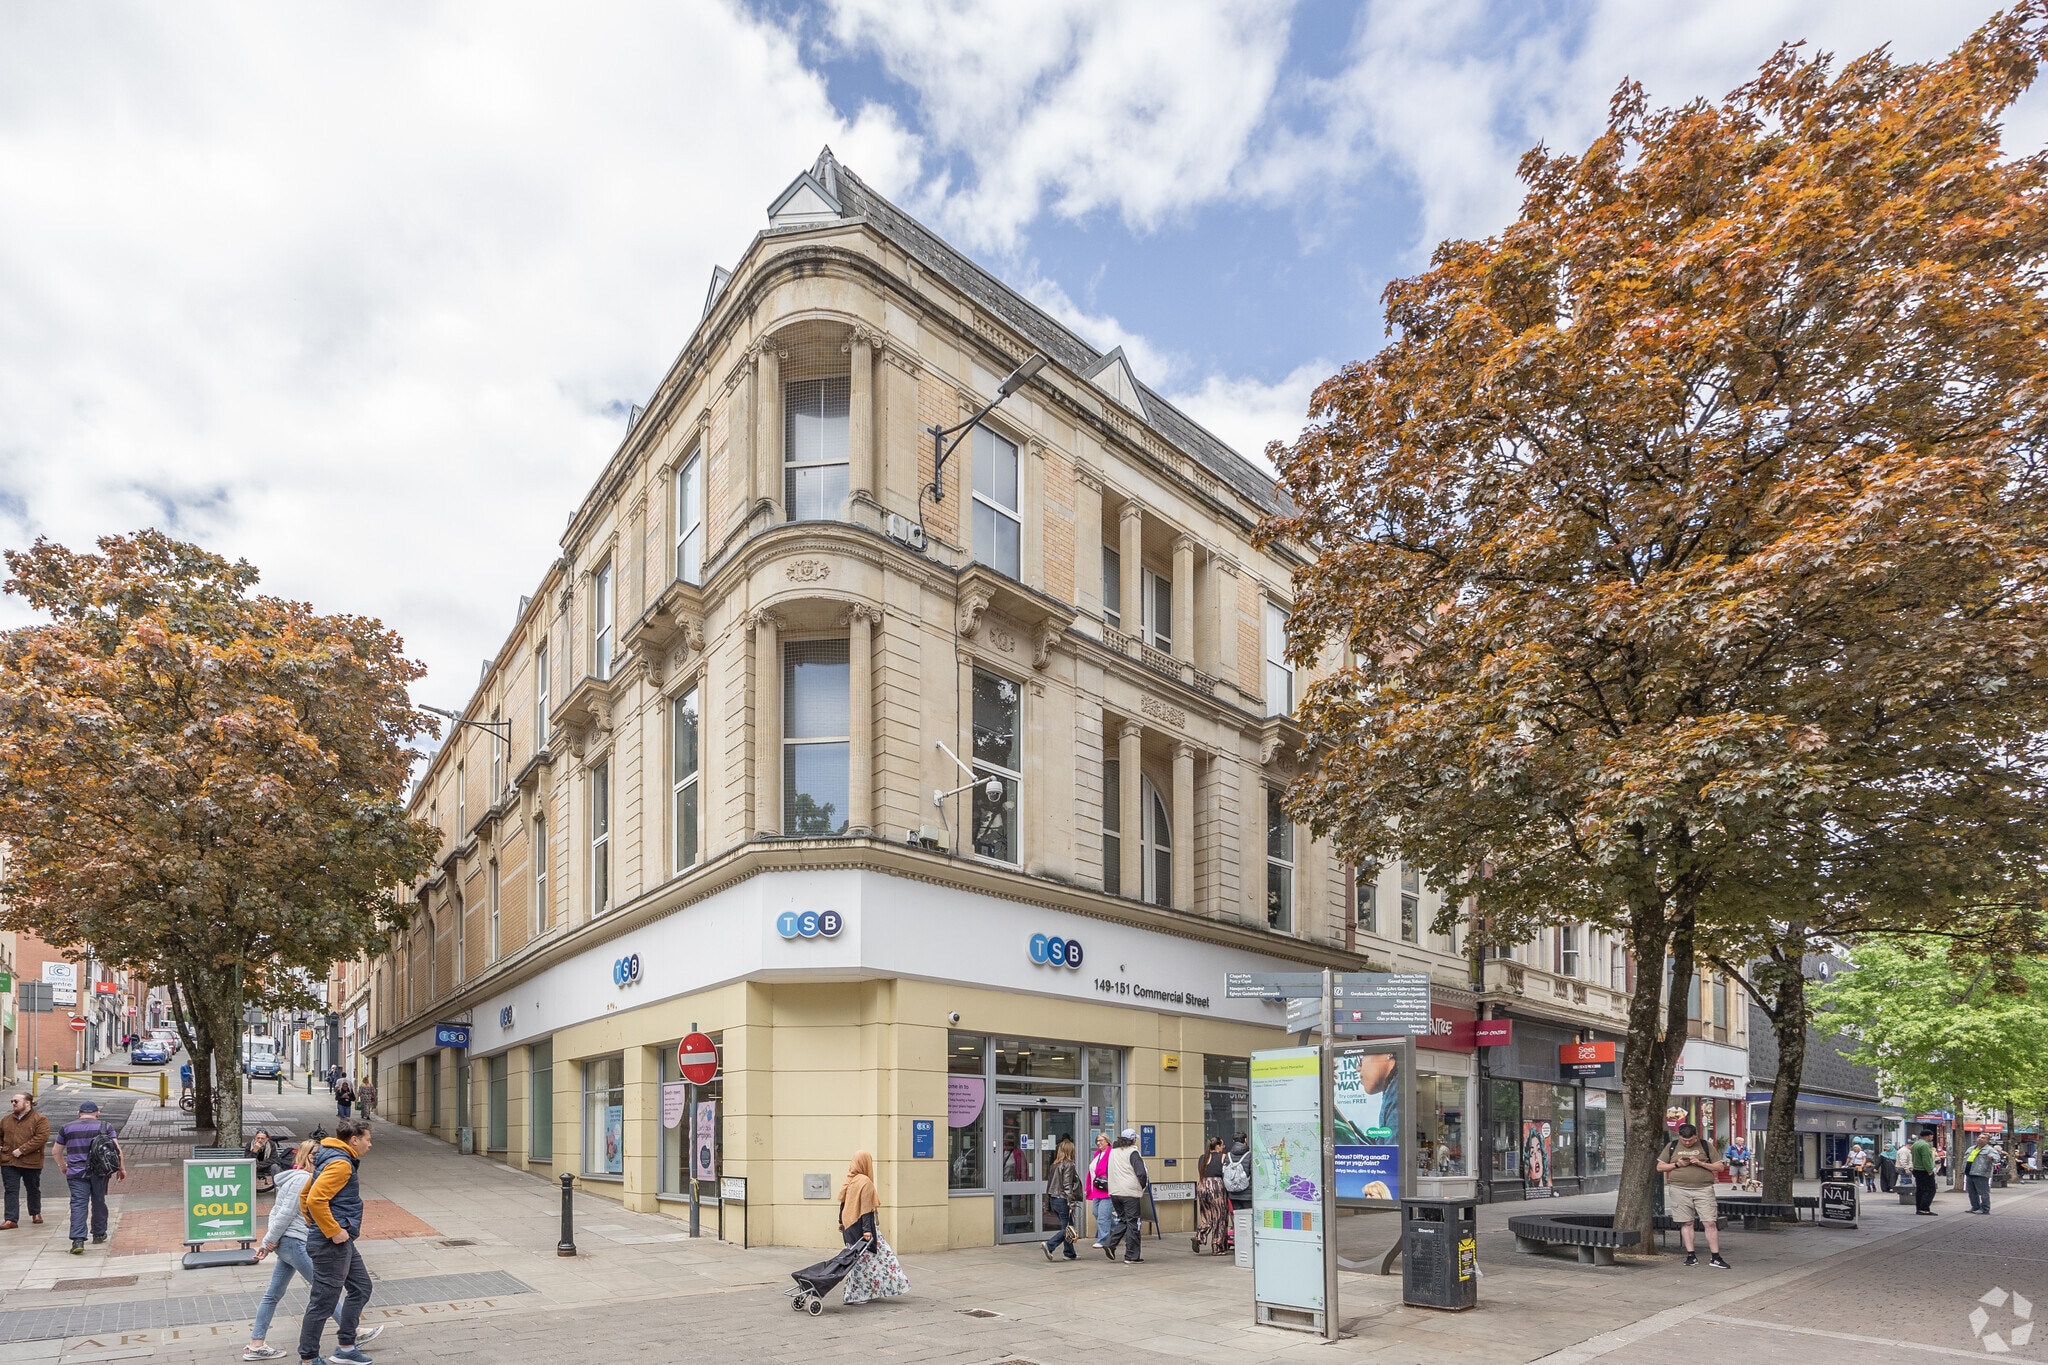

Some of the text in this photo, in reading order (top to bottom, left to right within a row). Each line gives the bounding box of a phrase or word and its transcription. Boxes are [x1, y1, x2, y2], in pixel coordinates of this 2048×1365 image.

[781, 914, 839, 932] TSB
[1034, 938, 1080, 964] TSB
[614, 957, 638, 982] TSB
[1094, 978, 1210, 1008] 149-151 Commercial Street
[1430, 1018, 1452, 1035] NTRE
[441, 1032, 465, 1042] TSB
[1578, 1045, 1596, 1053] Seel
[1343, 1059, 1357, 1071] IN
[1338, 1071, 1359, 1081] THE
[1337, 1081, 1361, 1091] WAY
[204, 1166, 236, 1178] WE
[201, 1184, 241, 1198] BUY
[728, 1189, 743, 1198] STREET
[1160, 1183, 1192, 1192] COMMERCIAL
[1824, 1189, 1854, 1201] NAIL
[193, 1202, 248, 1217] GOLD
[360, 1299, 498, 1320] TREET
